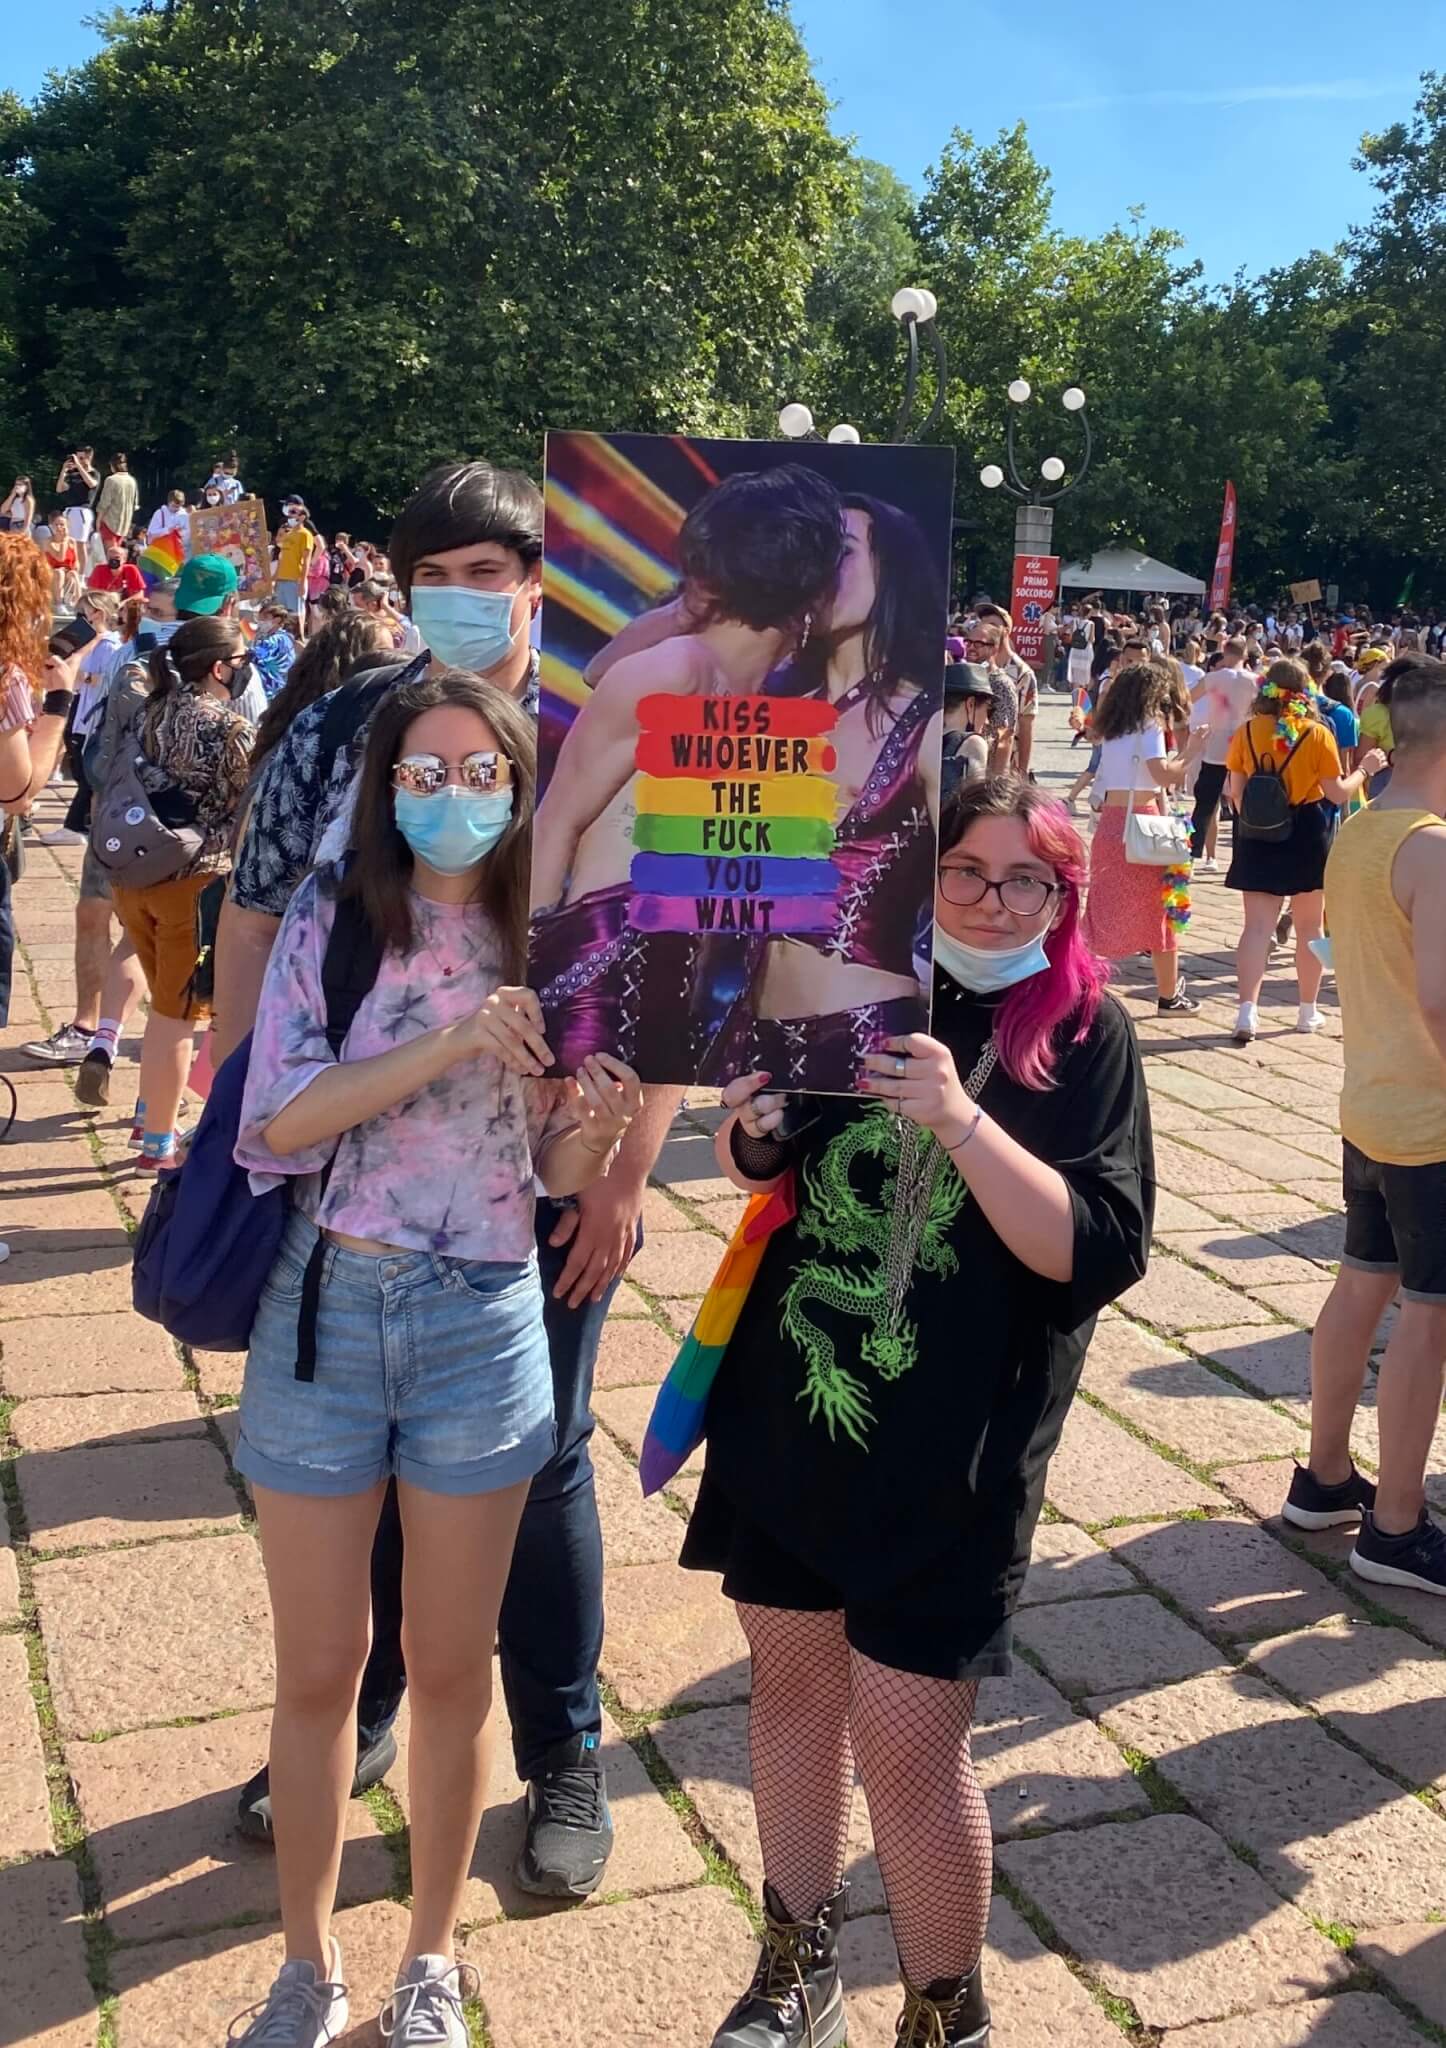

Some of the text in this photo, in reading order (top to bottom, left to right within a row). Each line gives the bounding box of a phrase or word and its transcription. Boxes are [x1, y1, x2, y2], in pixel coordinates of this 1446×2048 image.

[1016, 587, 1053, 599] SOCCORSO
[1023, 576, 1048, 586] PRIMO
[1016, 635, 1043, 645] FIRST
[1020, 647, 1037, 657] AID
[703, 700, 771, 733] KISS
[671, 734, 809, 773] WHOEVER
[711, 782, 761, 814] THE
[702, 819, 772, 852] FUCK
[704, 857, 762, 892] YOU
[695, 898, 775, 931] WANT
